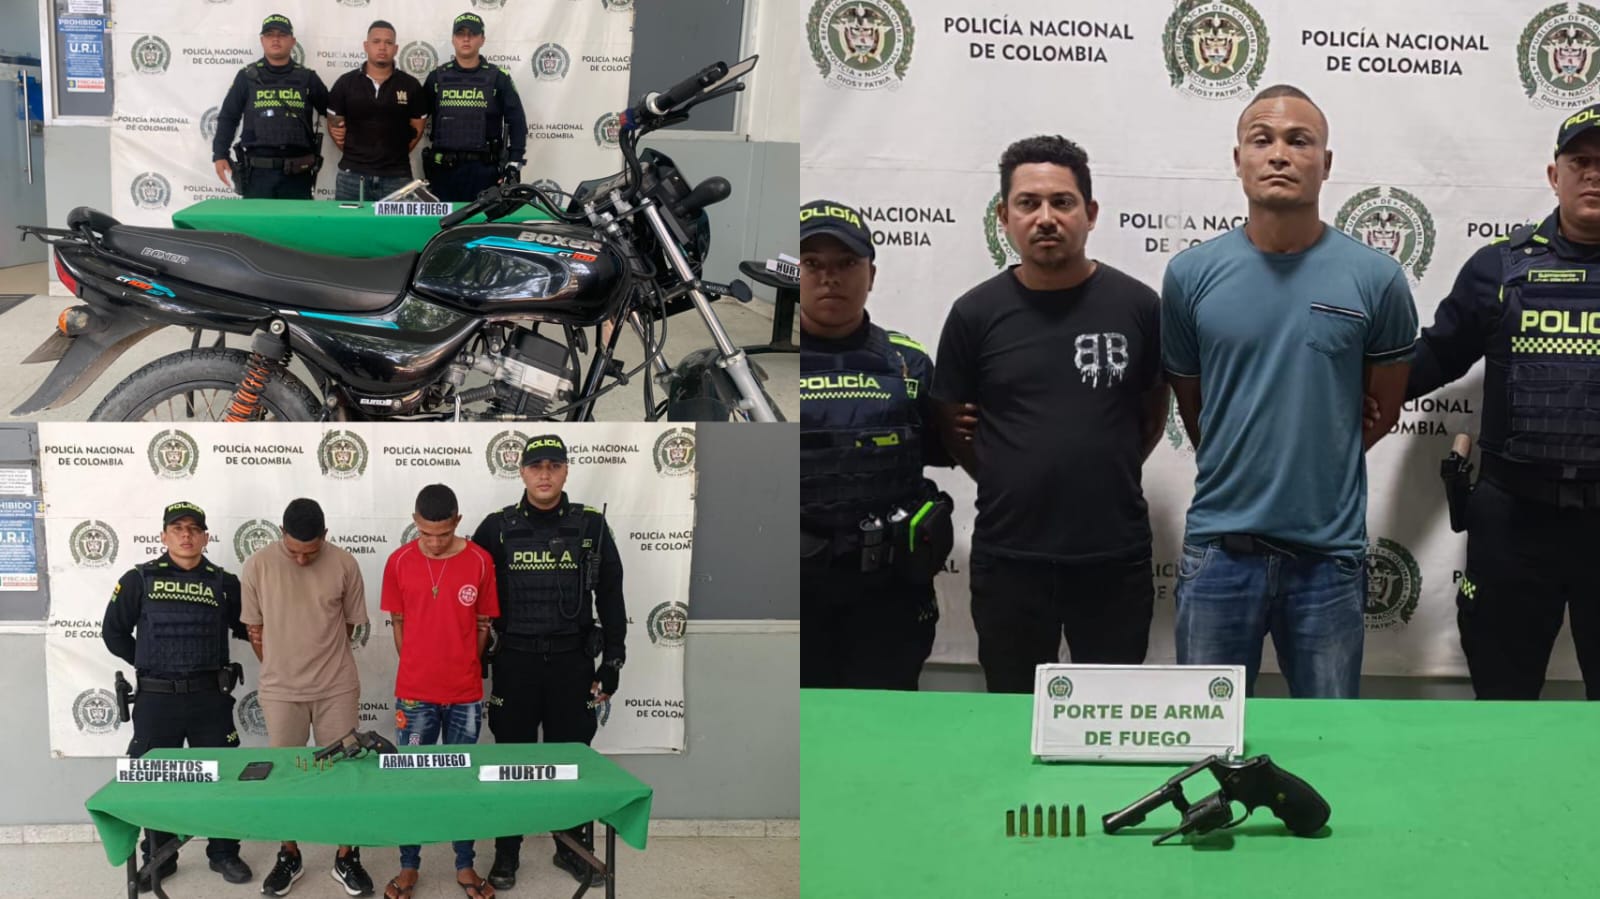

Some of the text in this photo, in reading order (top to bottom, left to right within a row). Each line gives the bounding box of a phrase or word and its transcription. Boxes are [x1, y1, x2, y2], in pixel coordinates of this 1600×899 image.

[944, 14, 1134, 40] POLICÍA NACIONAL
[1302, 27, 1489, 51] POLICÍA NACIONAL
[69, 43, 99, 54] U.R.I.
[970, 43, 1108, 63] DE COLOMBIA
[1327, 56, 1463, 75] DE COLOMBIA
[442, 87, 484, 100] POLICÍA
[378, 204, 449, 215] ARMA DE FUEGO
[800, 205, 861, 229] OLICÍA
[1346, 201, 1372, 232] PUBLICA
[518, 231, 602, 252] BOXER
[872, 230, 931, 246] OMBIA
[1145, 238, 1169, 252] DE
[141, 246, 190, 264] BOXER
[1521, 310, 1600, 334] POLIC
[1402, 398, 1473, 414] CIONAL
[45, 444, 135, 454] POLICÍA NACIONAL
[213, 443, 304, 454] POLICÍA NACIONAL
[383, 445, 472, 455] POLICÍA NACIONAL
[592, 445, 640, 453] NACIONAL
[58, 457, 124, 466] DE COLOMBIA
[226, 457, 292, 465] DE COLOMBIA
[396, 458, 461, 466] DE COLOMBIA
[578, 456, 627, 464] COLOMBIA
[339, 535, 387, 543] NACIONAL
[146, 547, 157, 555] DE
[641, 543, 652, 551] DE
[513, 551, 572, 563] POLICA
[154, 577, 215, 598] POLICÍA
[65, 630, 77, 638] DE
[1053, 704, 1224, 720] PORTE DE ARMA
[1085, 731, 1191, 746] DE FUEGO
[130, 760, 203, 772] ELEMENTOS
[383, 754, 465, 767] ARMA DE FUEGO
[119, 771, 213, 782] RECUPERADOS
[499, 766, 556, 780] HURTO
